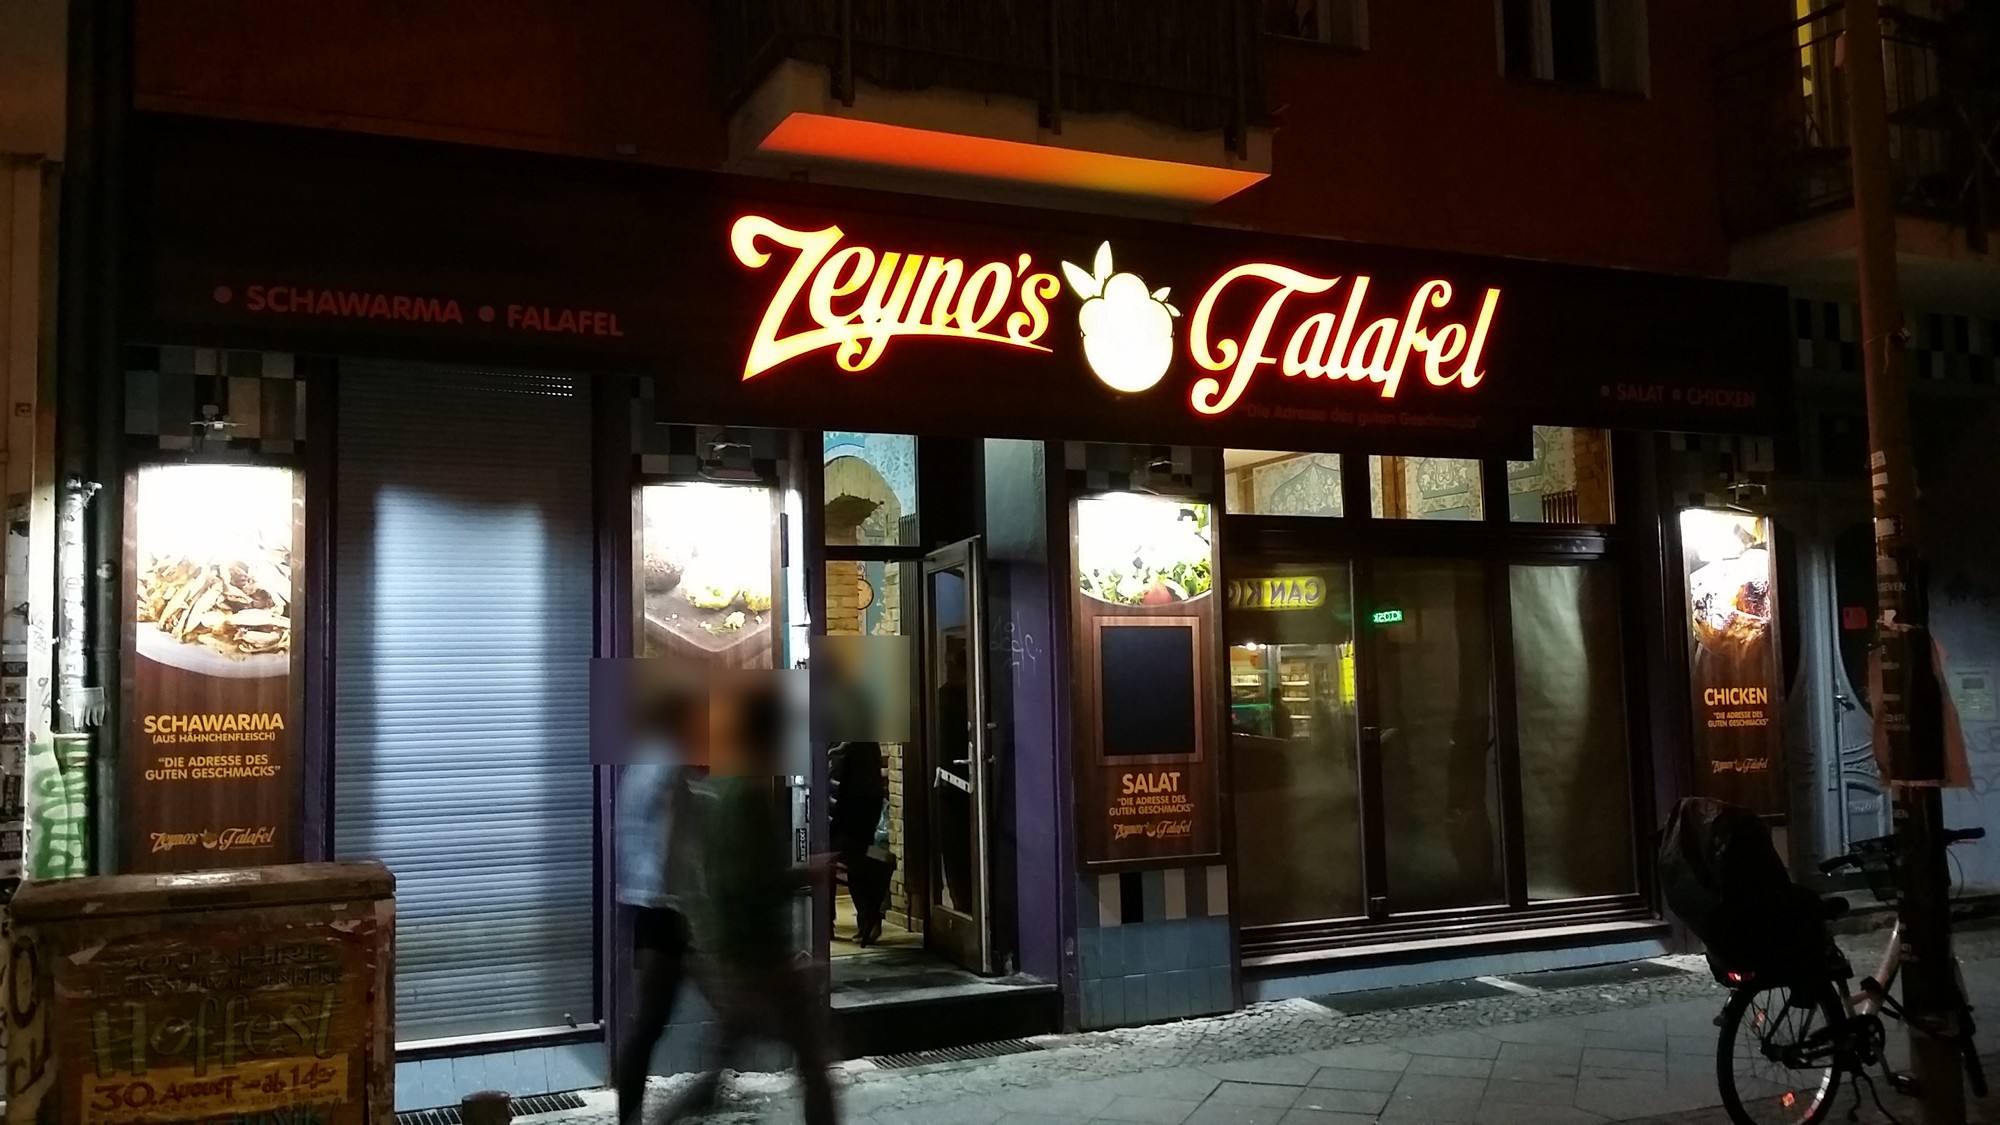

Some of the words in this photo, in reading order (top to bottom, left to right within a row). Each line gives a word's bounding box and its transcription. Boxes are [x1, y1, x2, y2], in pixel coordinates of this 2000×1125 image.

[245, 284, 464, 325] SCHAWARMA
[506, 303, 625, 337] FALAFEL
[730, 215, 1061, 381] Zeyno's
[1190, 262, 1501, 415] Falafel
[1616, 384, 1665, 402] SALAT
[1687, 386, 1756, 408] CHICKEN
[1330, 407, 1353, 424] des
[1358, 410, 1396, 428] guten
[1703, 687, 1769, 707] CHICKEN
[143, 712, 285, 734] SCHAWARMA
[1707, 719, 1728, 728] GUTEN
[1726, 710, 1752, 720] ADRESSE
[1751, 710, 1764, 719] DES
[152, 734, 177, 745] (AUS
[179, 731, 276, 743] HÄHNCHENFLEISCH)
[188, 754, 243, 768] ADRESSE
[245, 754, 269, 766] DES
[145, 768, 188, 781] GUTEN
[1121, 771, 1181, 795] SALAT
[1136, 795, 1170, 806] ADRESSE
[1171, 793, 1187, 804] DES
[1108, 807, 1136, 817] GUTEN
[218, 826, 276, 852] Falafel
[88, 989, 338, 1078] Hoffest
